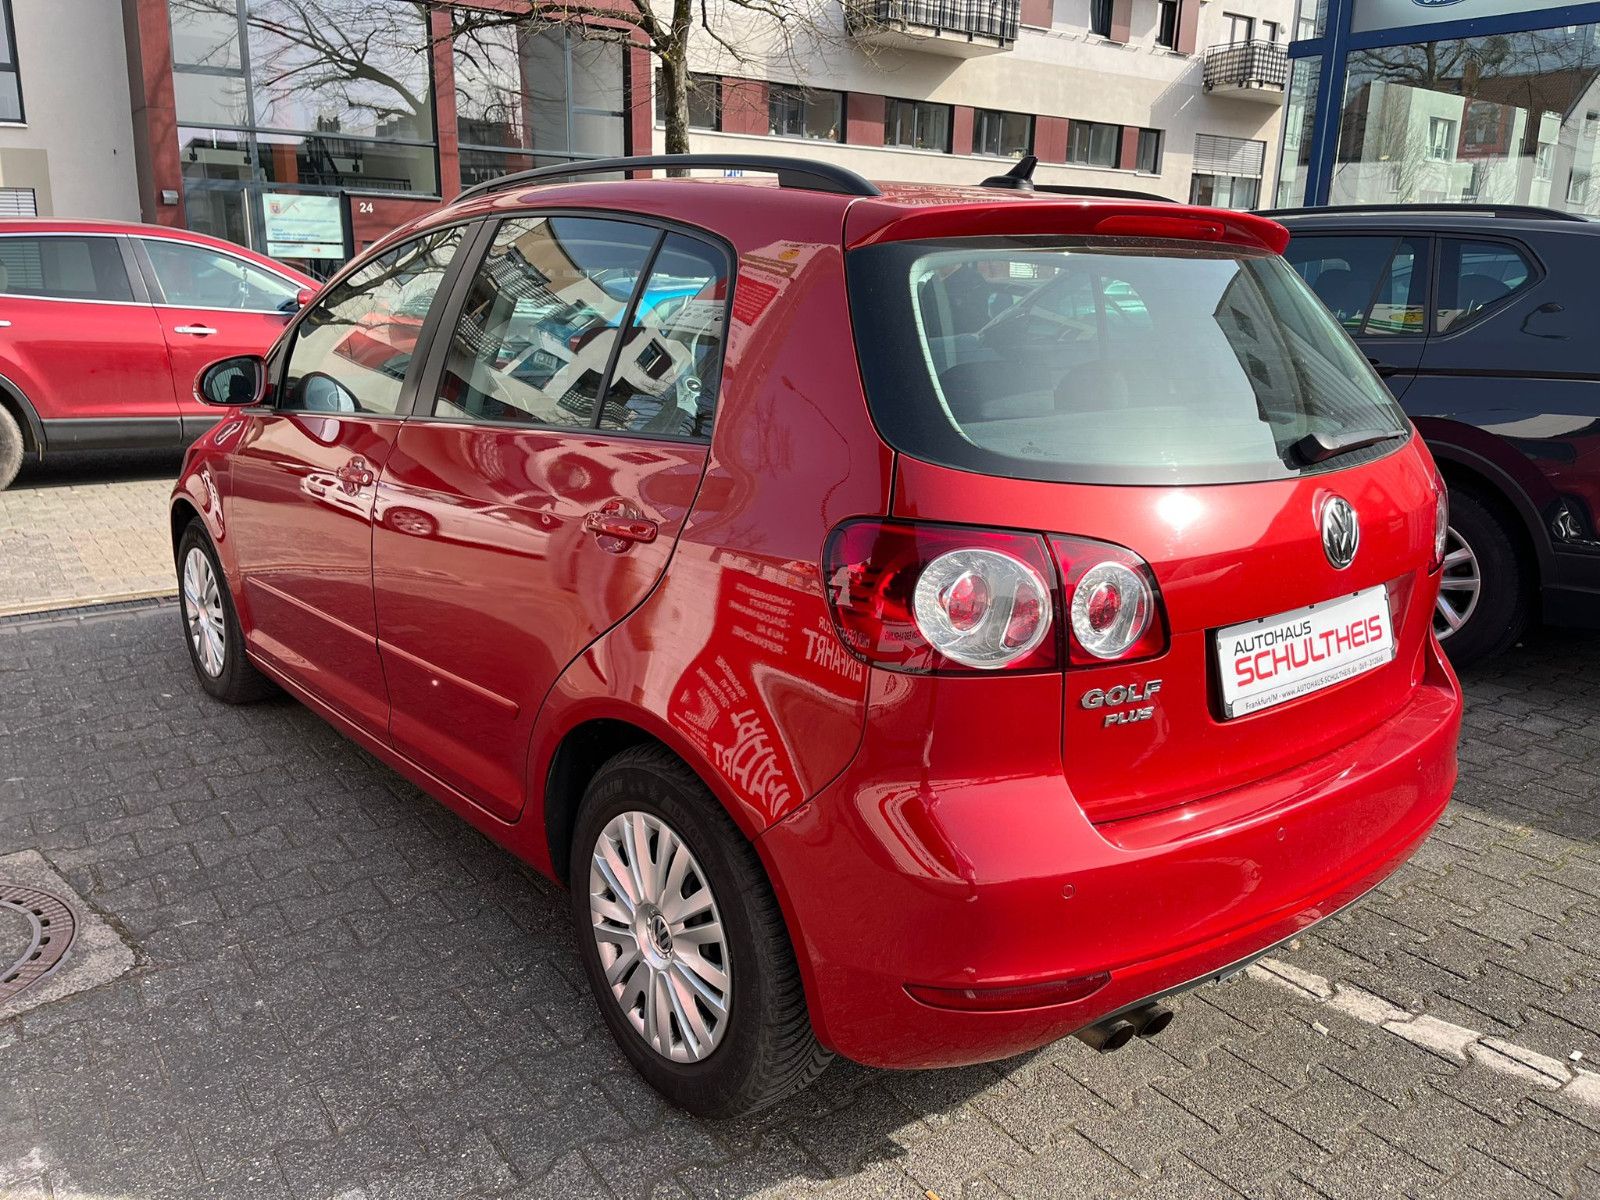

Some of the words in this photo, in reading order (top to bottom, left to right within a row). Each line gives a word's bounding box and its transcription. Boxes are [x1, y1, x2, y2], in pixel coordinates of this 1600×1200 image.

[359, 202, 374, 213] 24
[1234, 621, 1312, 656] AUTOHAUS
[1235, 615, 1383, 687] SCHULTHEIS
[1081, 679, 1162, 709] GOLF
[1245, 693, 1278, 710] Frankfurt/M
[1104, 706, 1154, 728] PLUS
